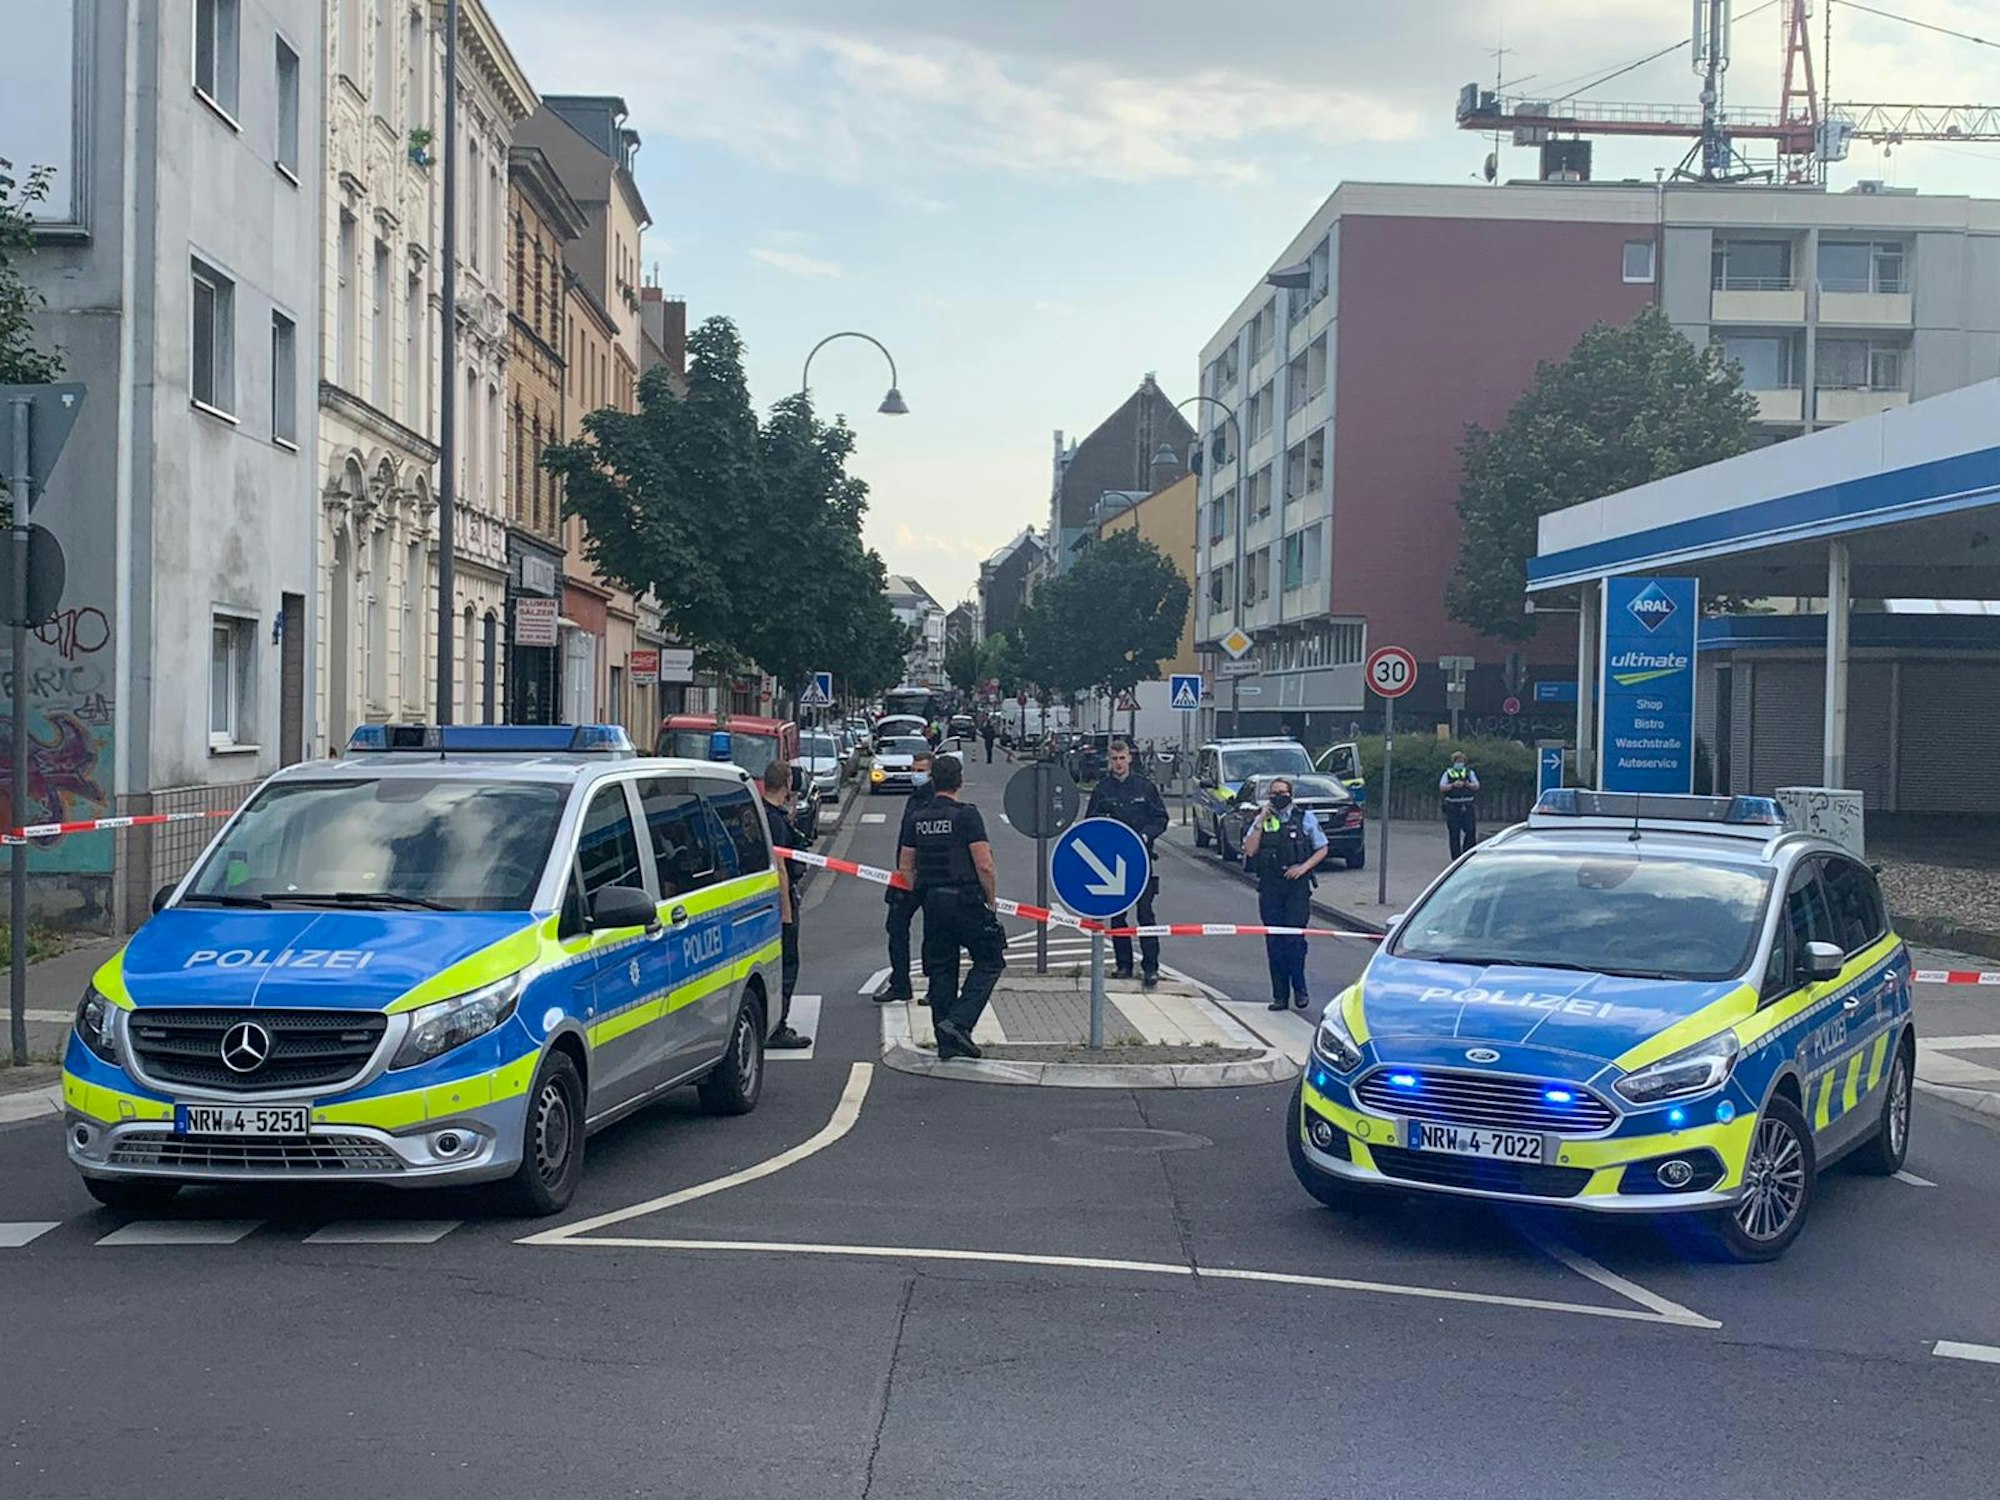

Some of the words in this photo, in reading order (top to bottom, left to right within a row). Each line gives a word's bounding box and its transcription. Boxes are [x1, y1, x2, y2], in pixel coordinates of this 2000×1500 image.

[1634, 600, 1671, 612] ARAL
[1611, 651, 1688, 667] ultimate
[1377, 661, 1405, 683] 30
[1636, 698, 1664, 711] Shop
[1634, 718, 1665, 730] Bistro
[1615, 737, 1681, 749] Waschstraße
[1617, 757, 1678, 769] Autoservice
[915, 819, 953, 835] POLIZEI
[859, 868, 890, 881] POLIZEI
[682, 923, 724, 969] POLIZEI
[182, 948, 375, 970] POLIZEI
[1418, 986, 1614, 1019] POLIZEI
[1813, 1016, 1848, 1060] POLIZEI
[187, 1109, 223, 1132] NRW
[233, 1109, 306, 1133] 4-5251
[1420, 1125, 1458, 1151] NRW
[1468, 1130, 1542, 1160] 4-7022
